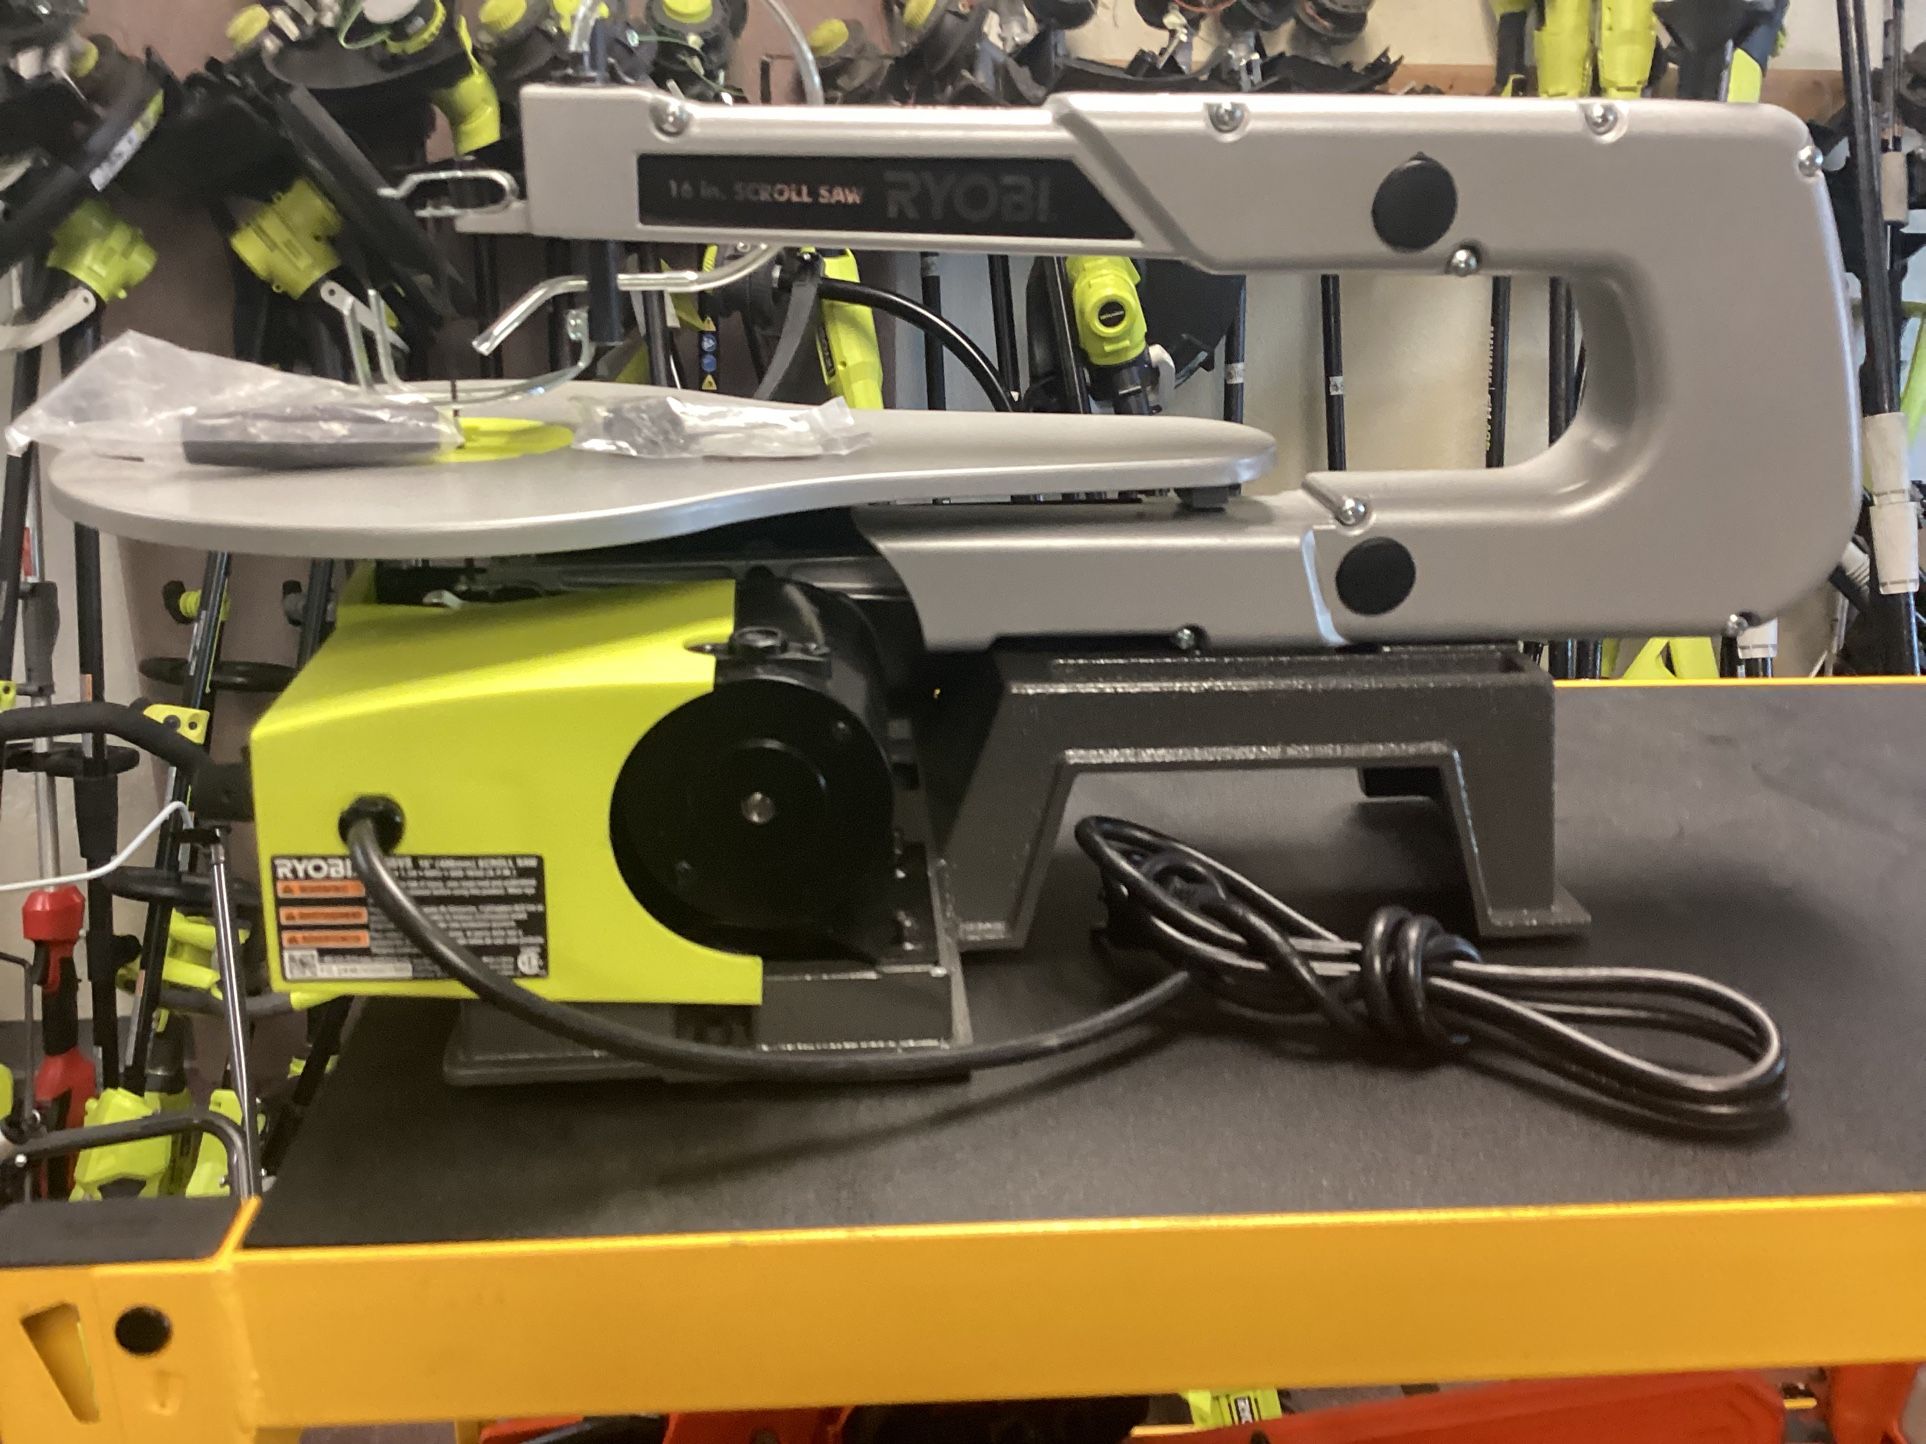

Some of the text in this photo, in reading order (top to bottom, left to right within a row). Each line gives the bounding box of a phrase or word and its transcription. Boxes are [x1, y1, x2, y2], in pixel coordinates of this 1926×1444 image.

[669, 178, 694, 199] 16
[733, 181, 813, 203] SCROLL
[817, 184, 862, 204] SAW
[882, 169, 1052, 223] RYOBI
[273, 858, 354, 879] RYOBI
